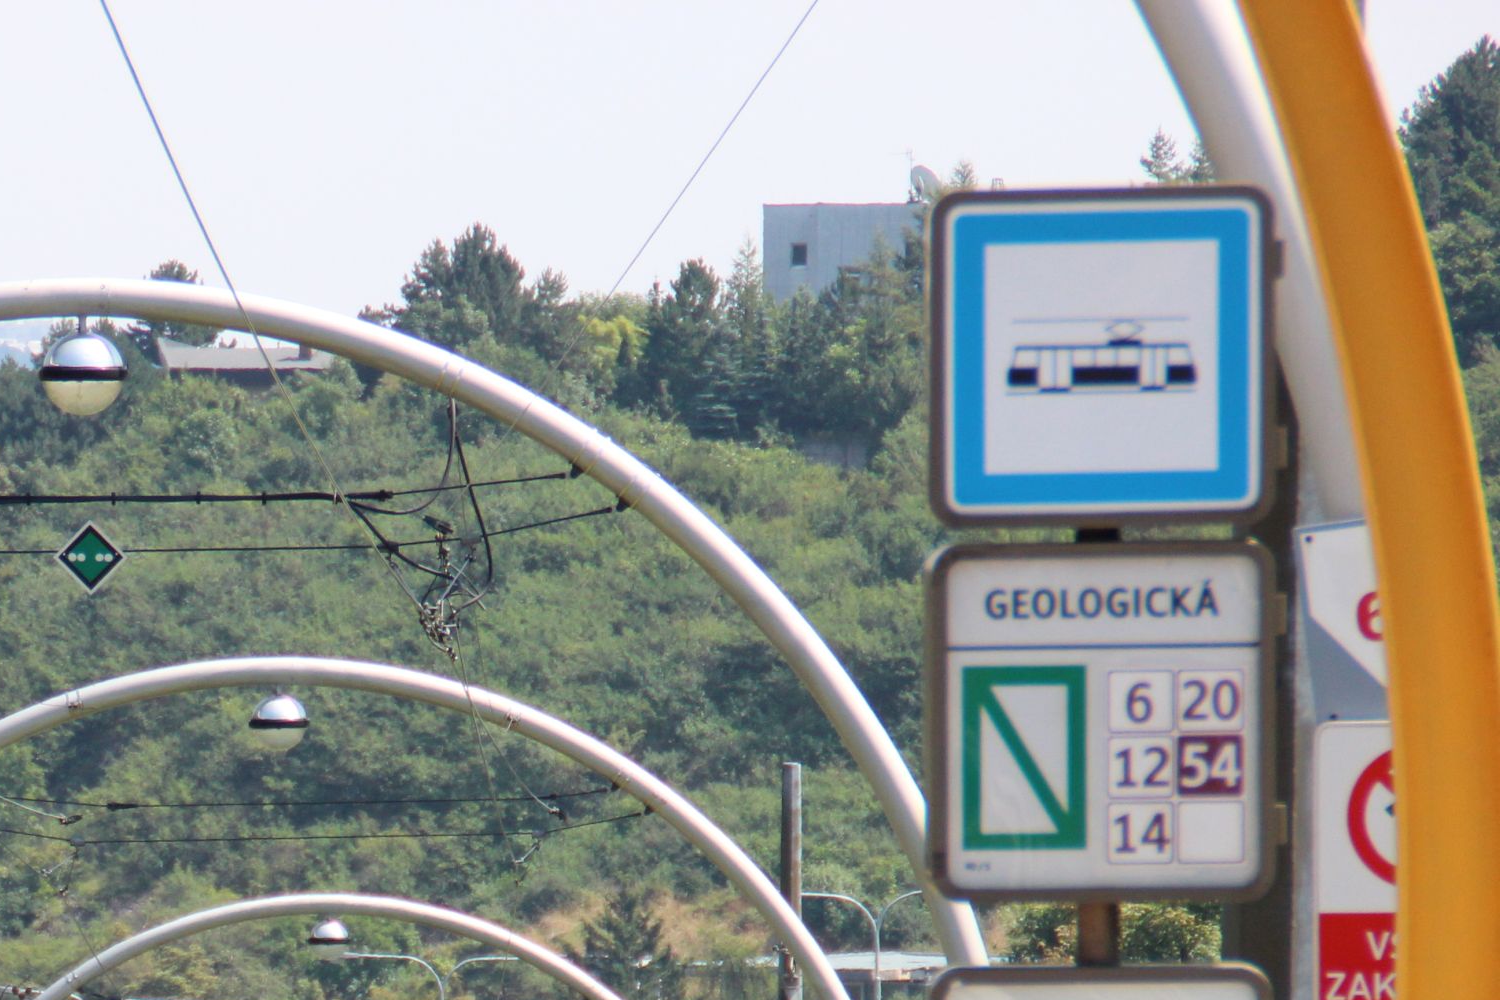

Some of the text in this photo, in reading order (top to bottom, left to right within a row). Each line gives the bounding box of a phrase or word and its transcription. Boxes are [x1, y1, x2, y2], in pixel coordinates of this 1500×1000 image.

[984, 578, 1219, 620] GEOLOGICKÁ
[1126, 679, 1240, 724] 6 20
[1115, 741, 1241, 789] 12 54
[1113, 813, 1170, 854] 14
